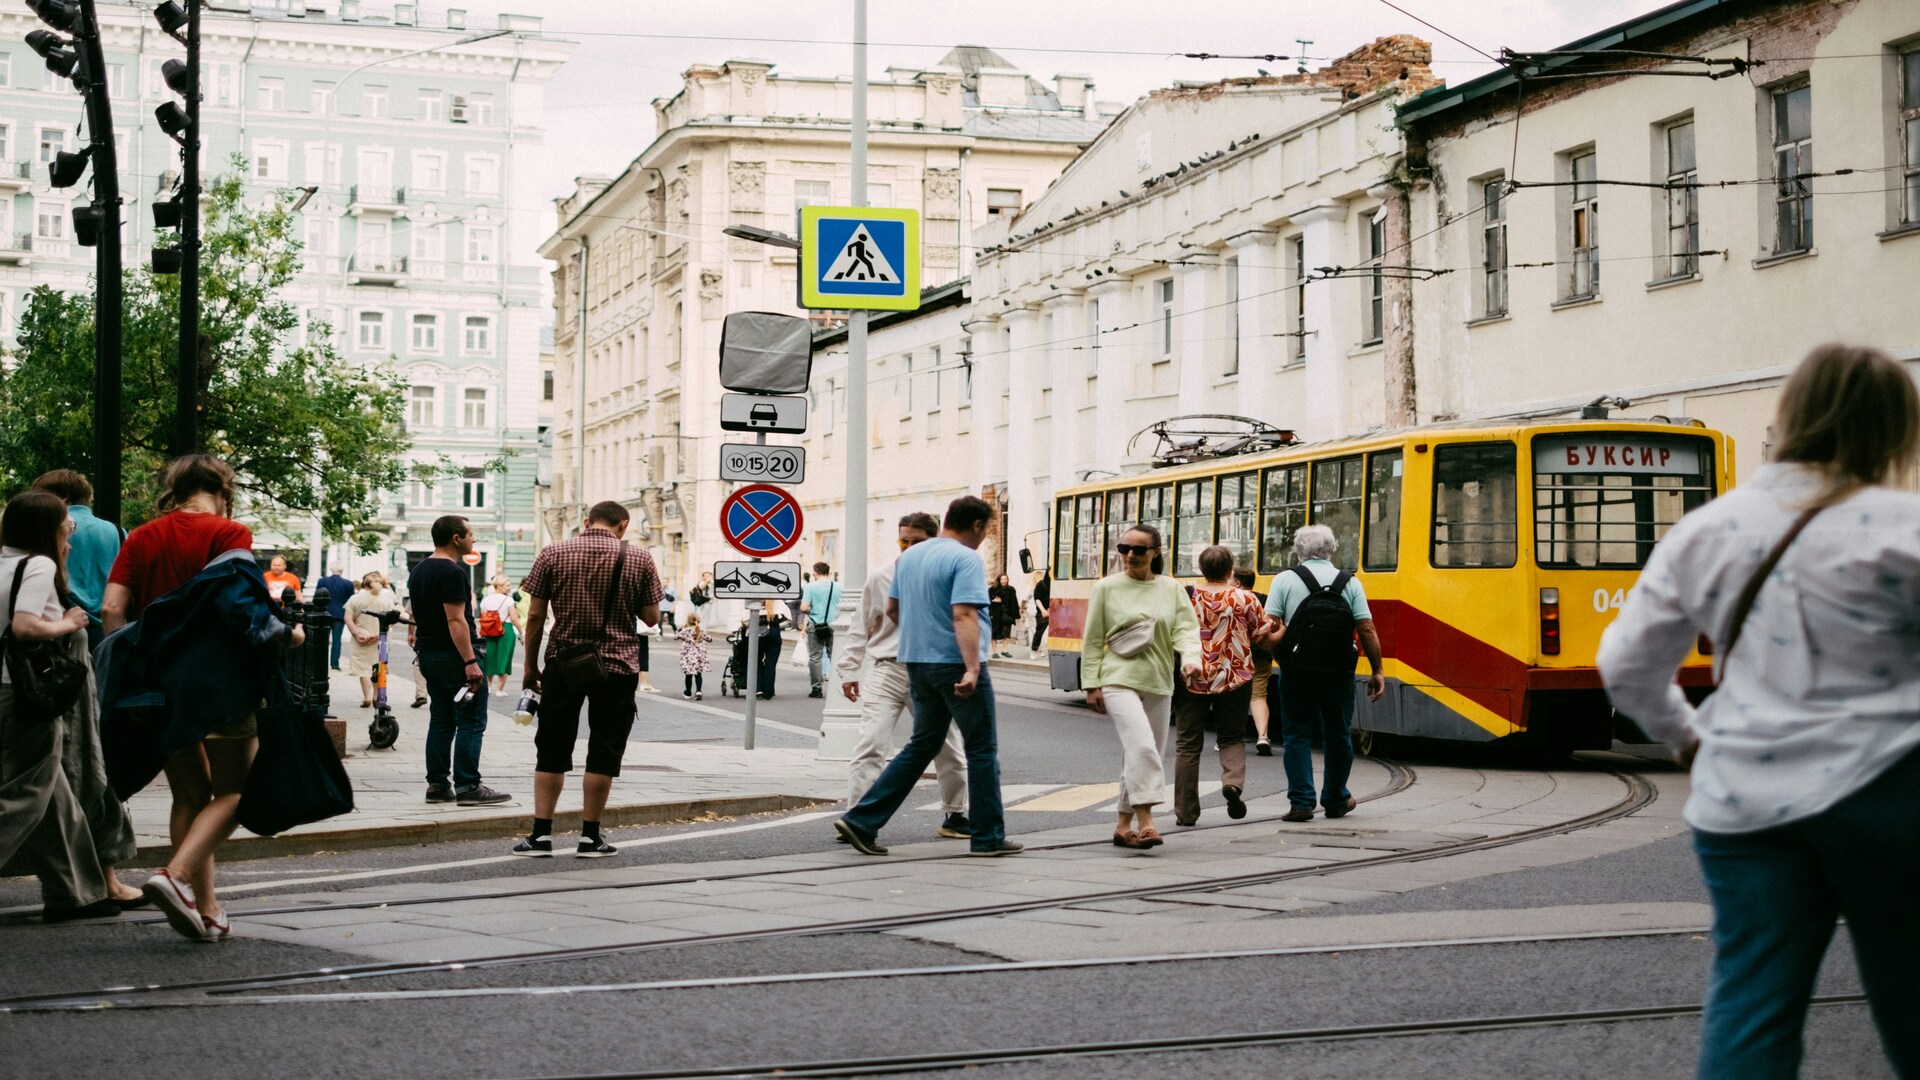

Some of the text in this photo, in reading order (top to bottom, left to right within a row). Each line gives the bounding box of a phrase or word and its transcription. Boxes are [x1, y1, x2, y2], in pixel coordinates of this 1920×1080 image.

[731, 456, 794, 473] 10 15 20
[1566, 446, 1671, 467] БУКСИР
[1593, 588, 1634, 613] 04
